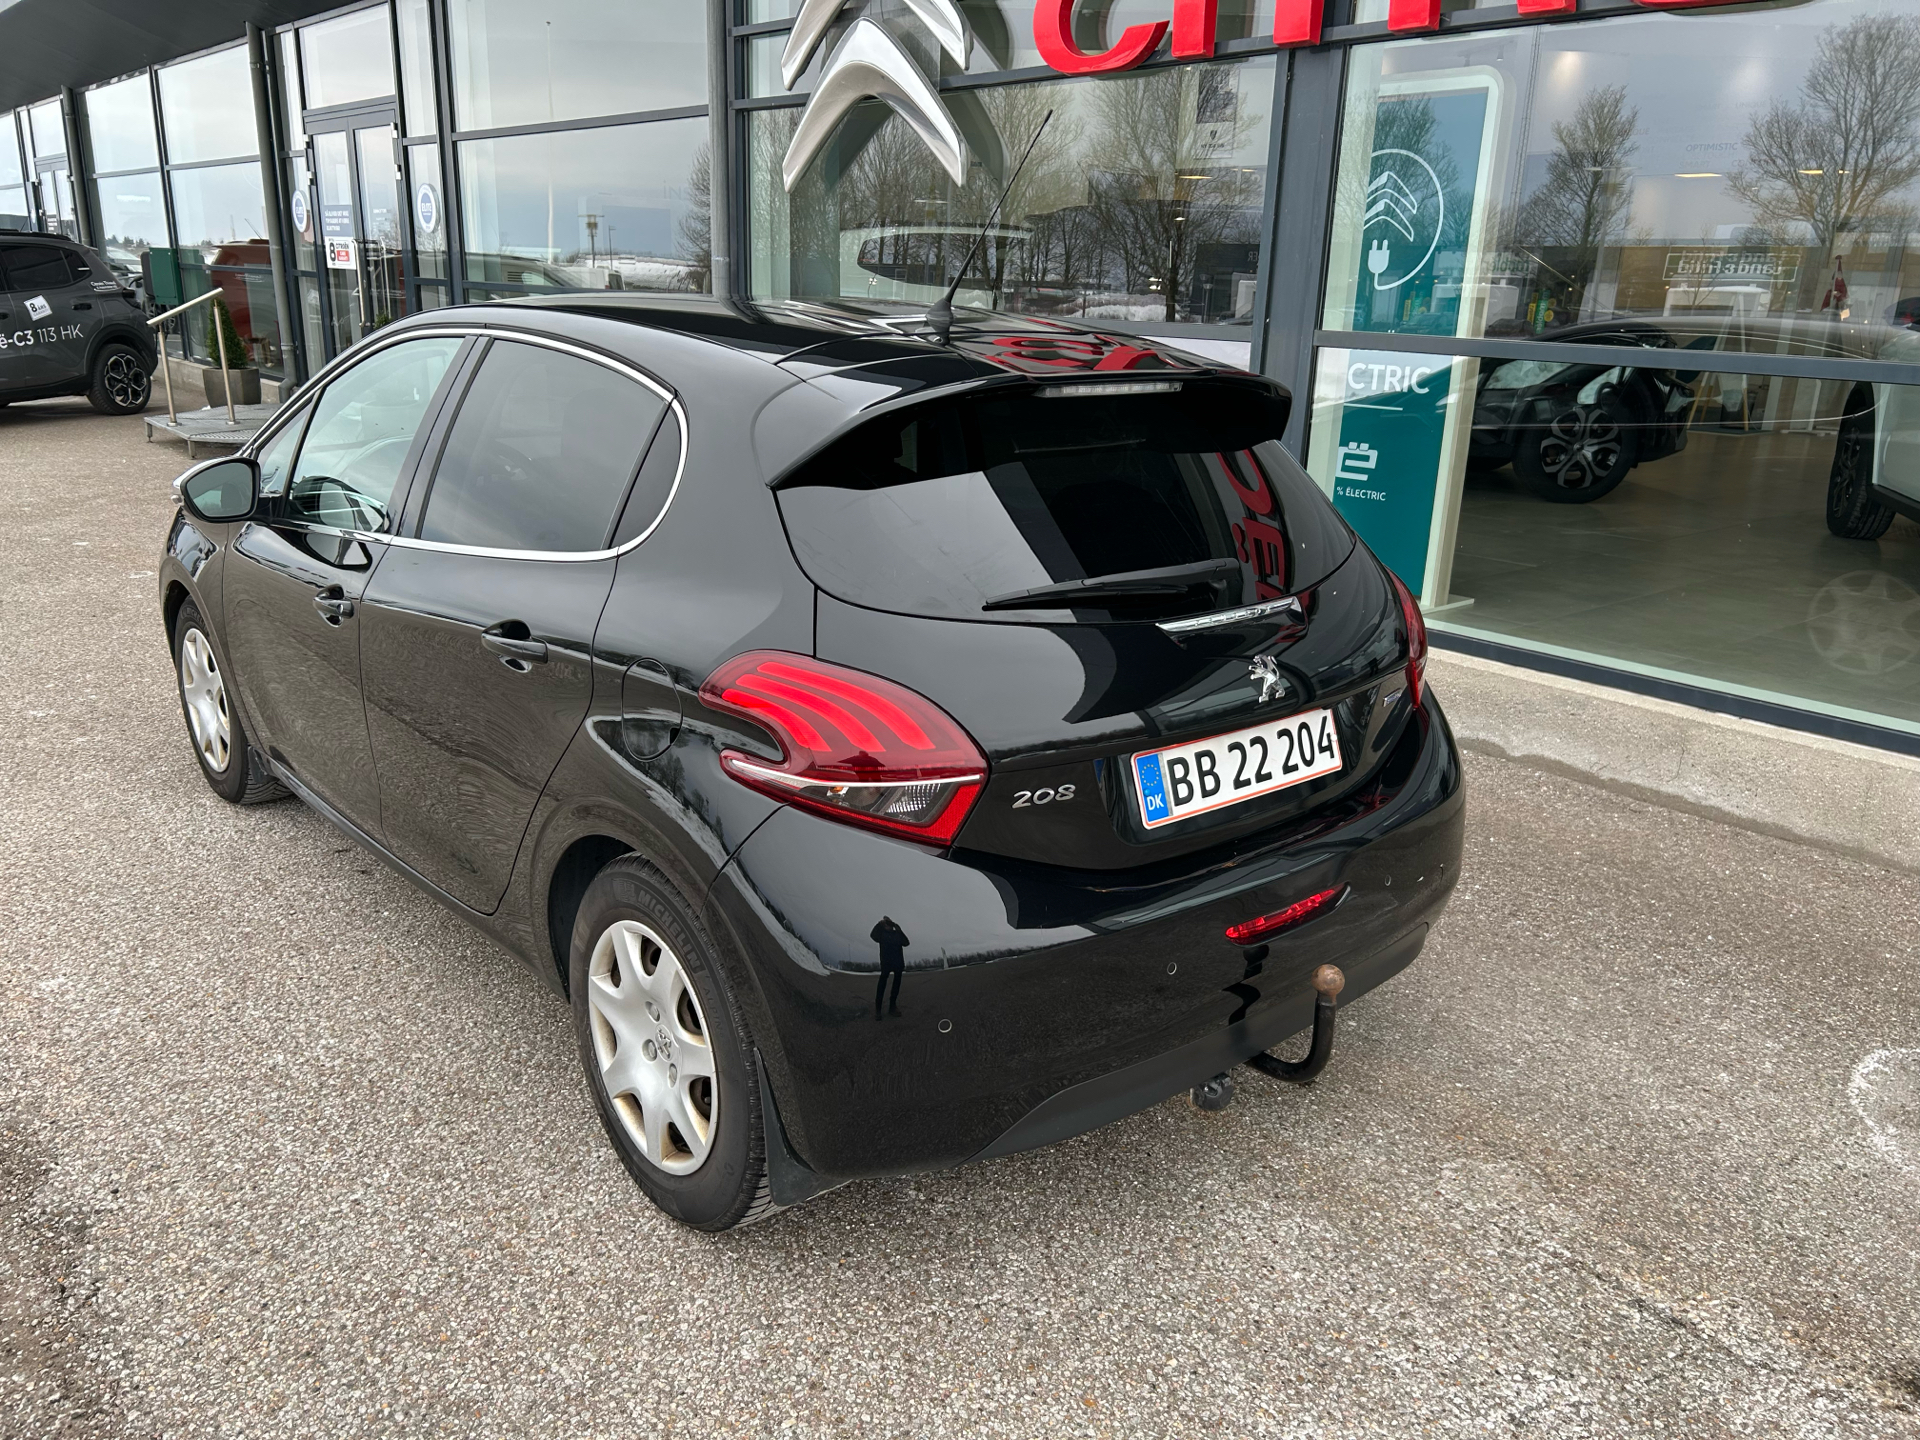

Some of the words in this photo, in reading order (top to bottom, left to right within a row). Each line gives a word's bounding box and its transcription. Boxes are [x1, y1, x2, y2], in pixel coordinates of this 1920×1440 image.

[1685, 142, 1738, 152] OPTIMISTIC
[329, 242, 336, 262] 8
[29, 302, 38, 312] 8
[36, 327, 57, 343] 113
[60, 323, 84, 340] HK
[1345, 486, 1387, 502] ËLECTRIC
[1167, 749, 1221, 807] BB
[1227, 735, 1273, 791] 22
[1276, 715, 1336, 776] 204
[1011, 784, 1076, 810] 208
[1146, 793, 1165, 811] DK
[638, 889, 700, 971] MICHELIN
